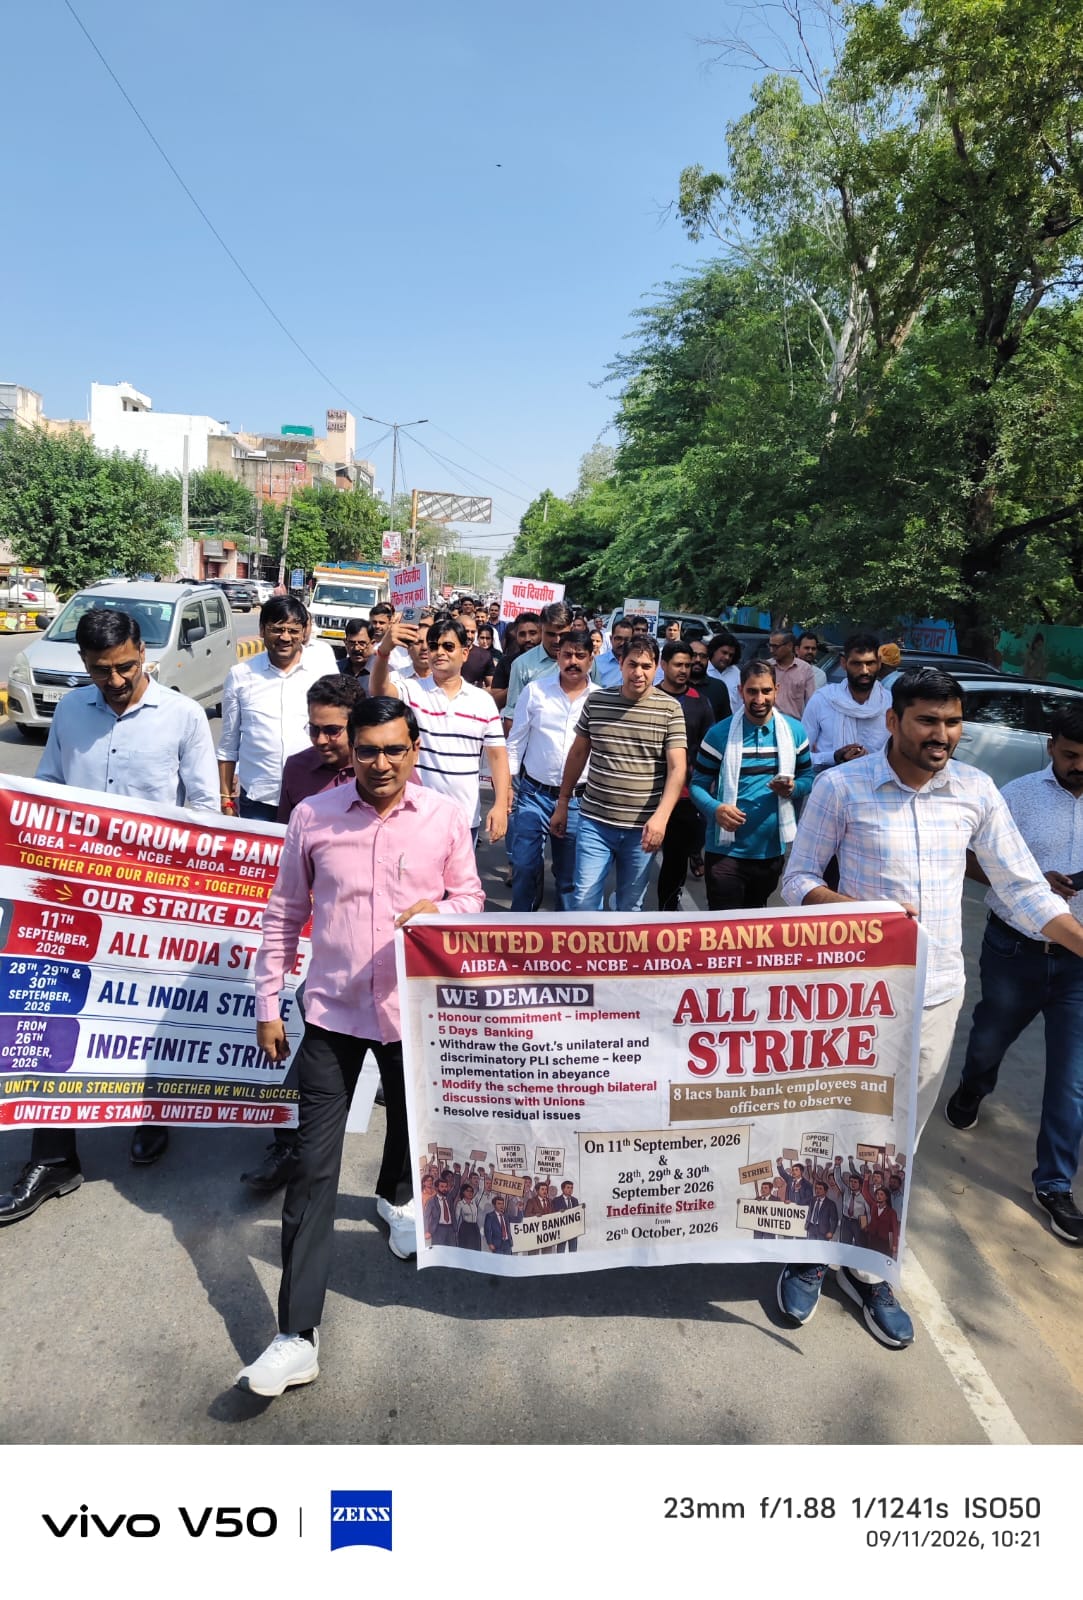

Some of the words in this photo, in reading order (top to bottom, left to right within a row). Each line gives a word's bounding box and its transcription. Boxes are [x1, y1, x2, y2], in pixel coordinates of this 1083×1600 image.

[512, 582, 527, 598] पांच
[527, 583, 554, 602] दिवसीय
[10, 800, 100, 837] UNITED
[106, 817, 190, 854] FORUM
[195, 832, 226, 858] OF
[18, 831, 64, 849] (AIBEA
[80, 841, 122, 857] AIBOC
[137, 850, 173, 865] NCBE
[186, 858, 225, 873] AIBOA
[239, 866, 266, 878] BEFI
[20, 851, 85, 874] TOGETHER
[87, 863, 112, 877] FOR
[115, 867, 142, 882] OUR
[145, 871, 190, 888] RIGHTS
[205, 879, 264, 898] TOGETHER
[82, 888, 134, 912] OUR
[142, 896, 229, 923] STRIKE
[40, 910, 74, 928] 11TH
[17, 926, 90, 948] SEPTEMBER,
[442, 931, 544, 954] UNITED
[551, 931, 649, 954] FORUM
[656, 929, 692, 952] OF
[700, 924, 775, 951] BANK
[781, 919, 884, 947] UNIONS
[36, 942, 65, 956] 2026
[108, 931, 150, 958] ALL
[158, 936, 219, 966] INDIA
[9, 962, 39, 976] 28TH,
[43, 964, 69, 976] 29TH
[72, 968, 81, 979] &
[460, 959, 508, 973] AIBEA
[523, 960, 571, 971] AIBOC
[586, 960, 628, 971] NCBE
[644, 958, 692, 970] AIBOA
[707, 956, 742, 969] BEFI
[756, 953, 803, 967] INBEF
[817, 951, 866, 964] INBOC
[29, 977, 57, 988] 30TH
[8, 990, 72, 1003] SEPTEMBER,
[97, 980, 139, 1006] ALL
[147, 985, 208, 1013] INDIA
[216, 993, 293, 1022] STRE
[440, 988, 478, 1006] WE
[484, 988, 590, 1007] DEMAND
[672, 988, 756, 1024] ALL
[767, 980, 895, 1020] INDIA
[24, 1001, 51, 1012] 2026
[438, 1012, 481, 1023] Honour
[484, 1012, 562, 1023] commitment
[575, 1011, 640, 1022] implement
[16, 1021, 47, 1031] FROM
[438, 1025, 446, 1034] 5
[449, 1026, 478, 1037] Days
[484, 1027, 534, 1039] Banking
[15, 1032, 43, 1045] 26TH
[440, 1040, 496, 1051] Withdraw
[499, 1041, 519, 1051] the
[566, 1038, 624, 1050] unilateral
[626, 1037, 649, 1048] and
[2, 1046, 52, 1058] OCTOBER,
[87, 1034, 212, 1063] INDEFINITE
[688, 1025, 877, 1076] STRIKE
[11, 1058, 38, 1068] 2026
[440, 1052, 526, 1067] discriminatory
[530, 1056, 549, 1066] PLI
[552, 1054, 599, 1066] scheme
[612, 1052, 642, 1064] keep
[441, 1066, 534, 1080] implementation
[538, 1070, 549, 1079] in
[552, 1069, 610, 1081] abeyance
[5, 1080, 40, 1094] UNITY
[43, 1081, 55, 1093] IS
[58, 1081, 84, 1094] OUR
[86, 1081, 145, 1094] STRENGTH
[157, 1082, 210, 1095] TOGETHER
[214, 1084, 229, 1096] WE
[232, 1085, 256, 1098] WILL
[260, 1087, 300, 1100] SUCCEE
[442, 1080, 482, 1092] Modify
[485, 1082, 504, 1092] the
[507, 1082, 554, 1093] scheme
[557, 1083, 605, 1095] through
[607, 1081, 657, 1092] bilateral
[673, 1088, 681, 1101] 8
[685, 1088, 712, 1100] lacs
[716, 1087, 746, 1099] bank
[750, 1084, 783, 1097] bank
[786, 1078, 856, 1096] employees
[861, 1080, 887, 1093] and
[442, 1093, 511, 1105] discussions
[514, 1096, 540, 1106] with
[543, 1097, 585, 1106] Unions
[730, 1101, 780, 1114] officers
[783, 1099, 795, 1109] to
[799, 1094, 852, 1108] observe
[13, 1105, 74, 1120] UNITED
[77, 1105, 101, 1120] WE
[104, 1105, 155, 1120] STAND,
[161, 1105, 211, 1120] UNITED
[217, 1106, 238, 1120] WE
[242, 1106, 275, 1120] WIN!
[443, 1106, 489, 1117] Resolve
[492, 1108, 539, 1120] residual
[543, 1110, 581, 1120] issues
[585, 1140, 604, 1153] On
[608, 1138, 630, 1152] 11th
[634, 1136, 707, 1154] September,
[710, 1134, 741, 1147] 2026
[804, 1147, 829, 1156] SCHEME
[659, 1155, 668, 1166] &
[618, 1170, 645, 1184] 28th,
[648, 1168, 671, 1182] 29th
[674, 1169, 683, 1180] &
[686, 1165, 709, 1178] 30th
[742, 1167, 769, 1179] STRIKE
[494, 1178, 523, 1190] STRIKE
[612, 1184, 680, 1201] September
[684, 1181, 714, 1193] 2026
[606, 1203, 672, 1218] Indefinite
[675, 1199, 715, 1212] Strike
[743, 1205, 768, 1215] BANK
[770, 1206, 806, 1219] UNIONS
[514, 1222, 540, 1235] 5-DAY
[542, 1212, 580, 1230] BANKING
[606, 1228, 629, 1241] 26th
[631, 1226, 686, 1238] October,
[689, 1222, 718, 1234] 2026
[757, 1219, 791, 1230] UNITED
[536, 1231, 561, 1244] NOW!
